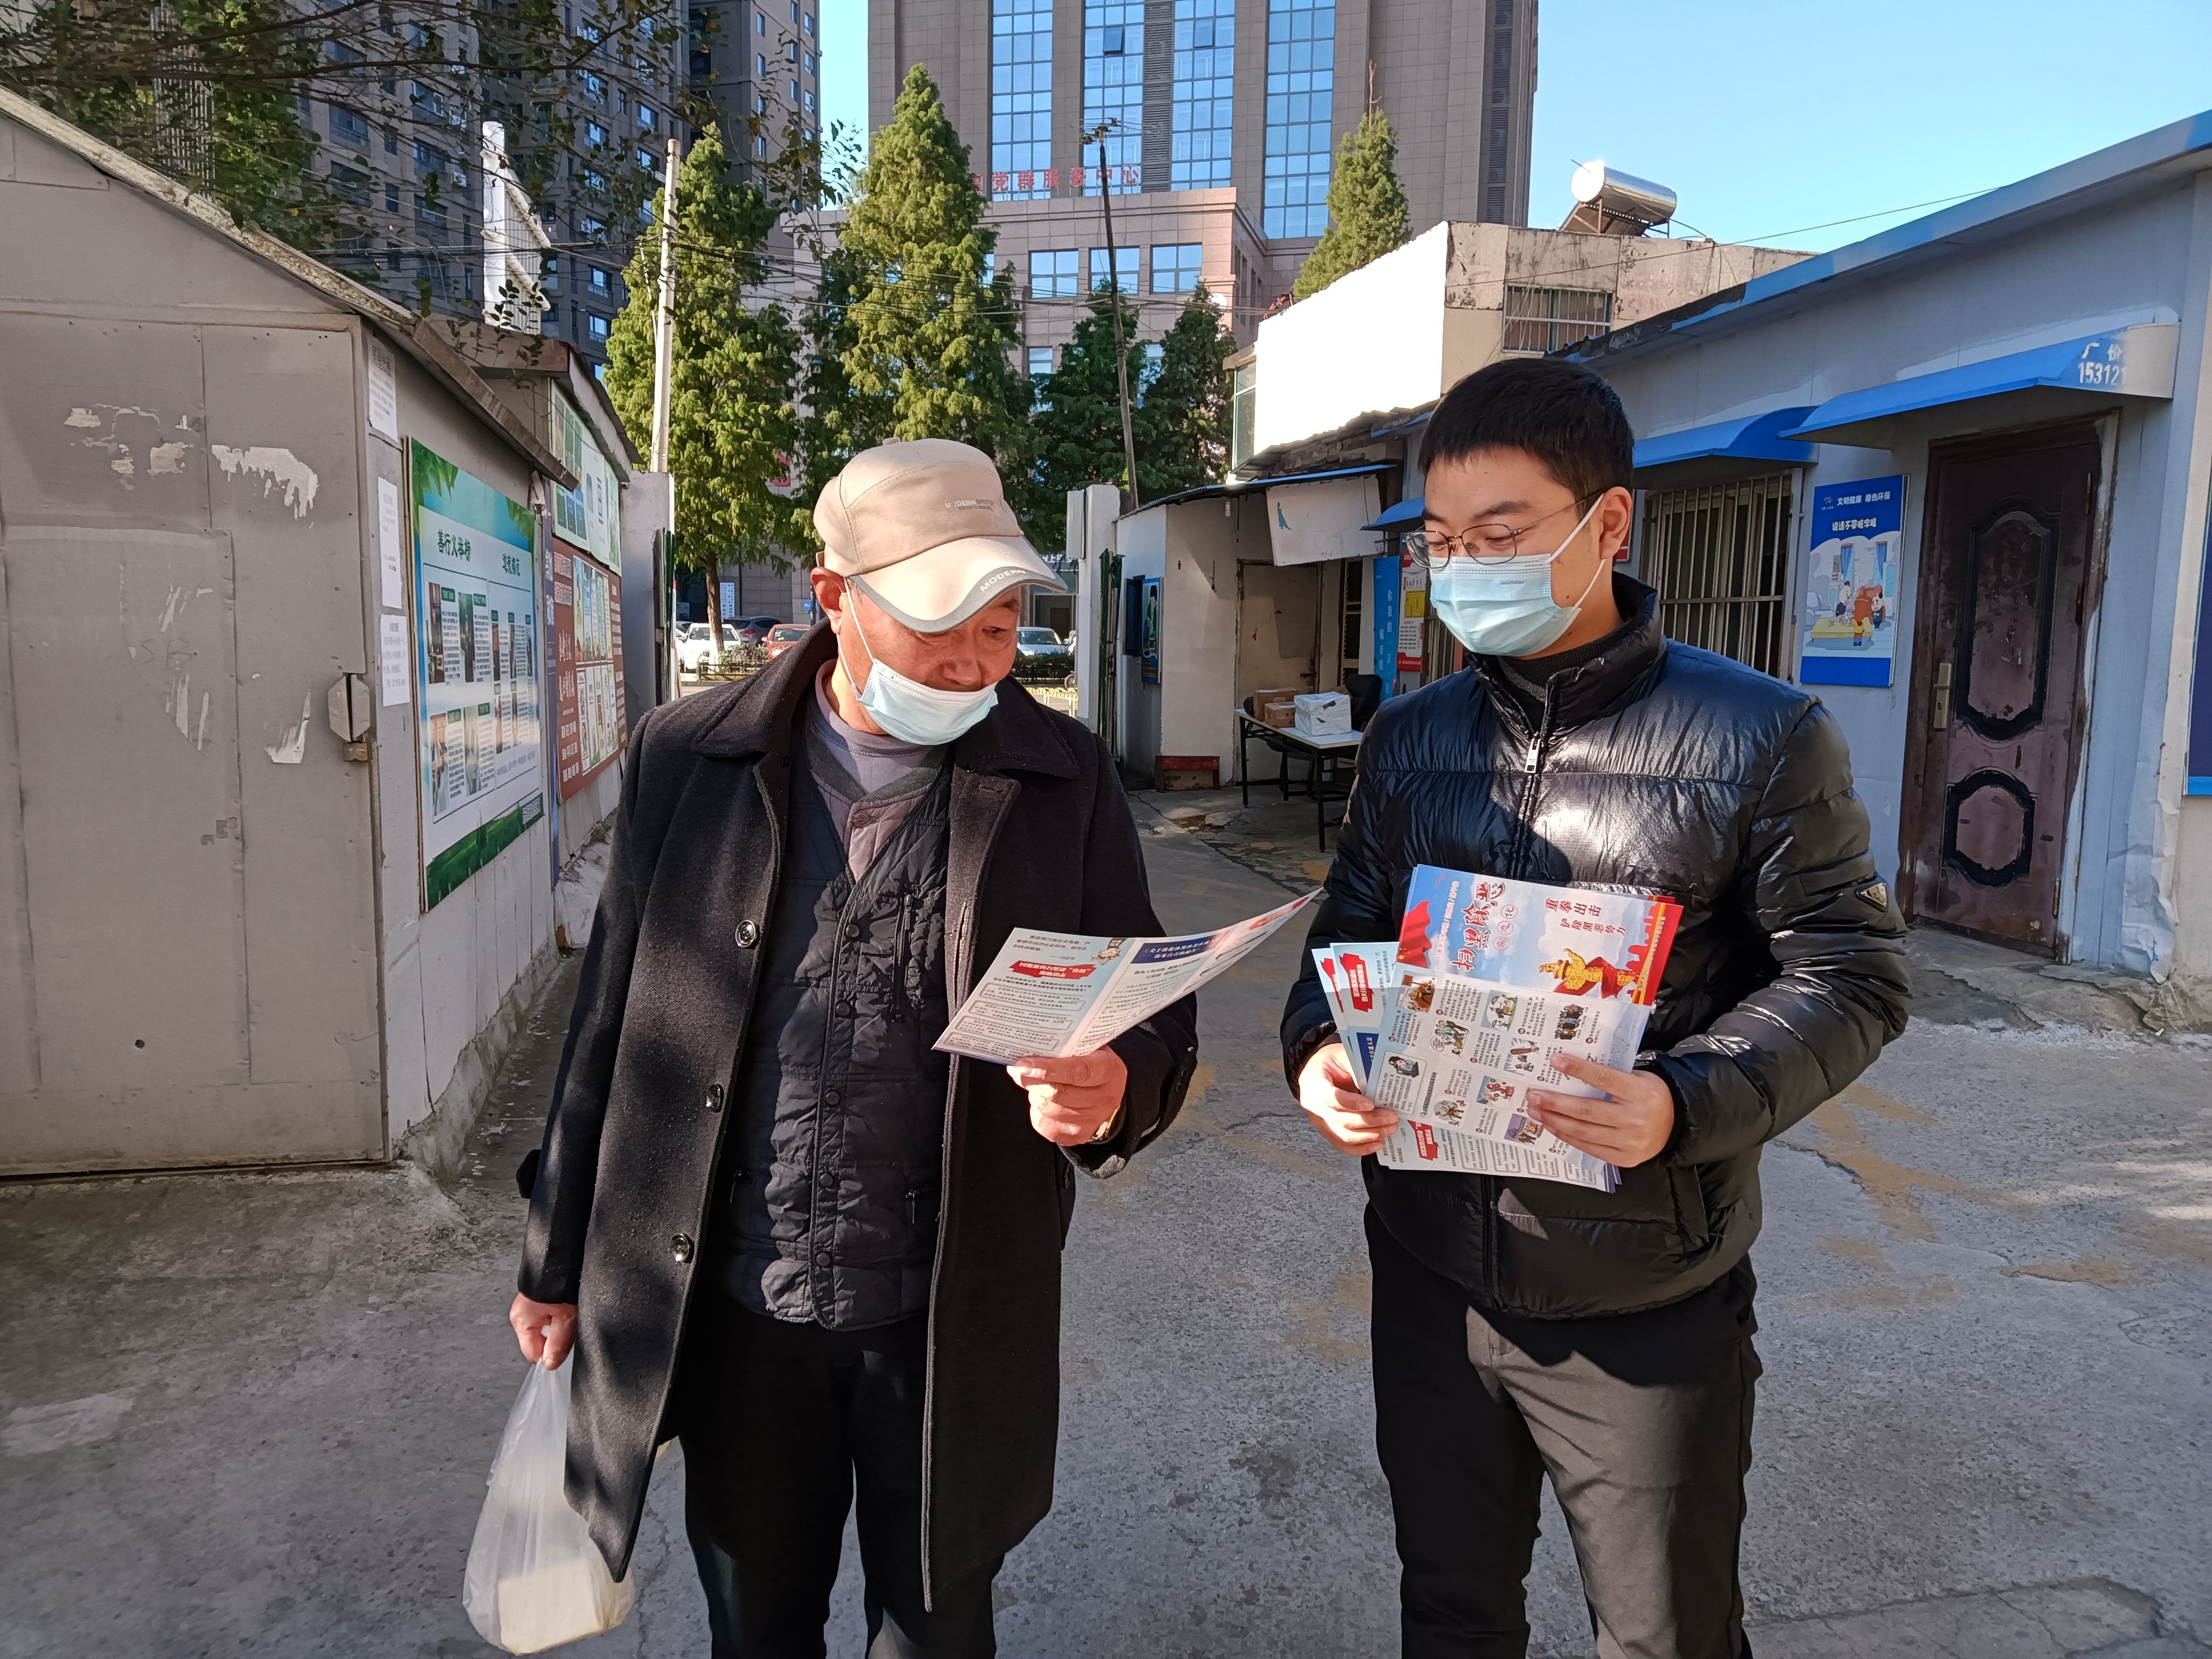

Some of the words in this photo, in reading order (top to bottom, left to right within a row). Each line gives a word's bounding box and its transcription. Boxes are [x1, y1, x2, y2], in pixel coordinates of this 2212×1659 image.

[1837, 495, 1862, 506] 文明健康
[1865, 491, 1891, 502] 绿色环保
[979, 569, 1027, 592] MODERN
[1544, 897, 1603, 917] 重拳出击
[1449, 881, 1506, 973] 扫黑除恶
[1560, 917, 1627, 936] 铲除黑恶势力
